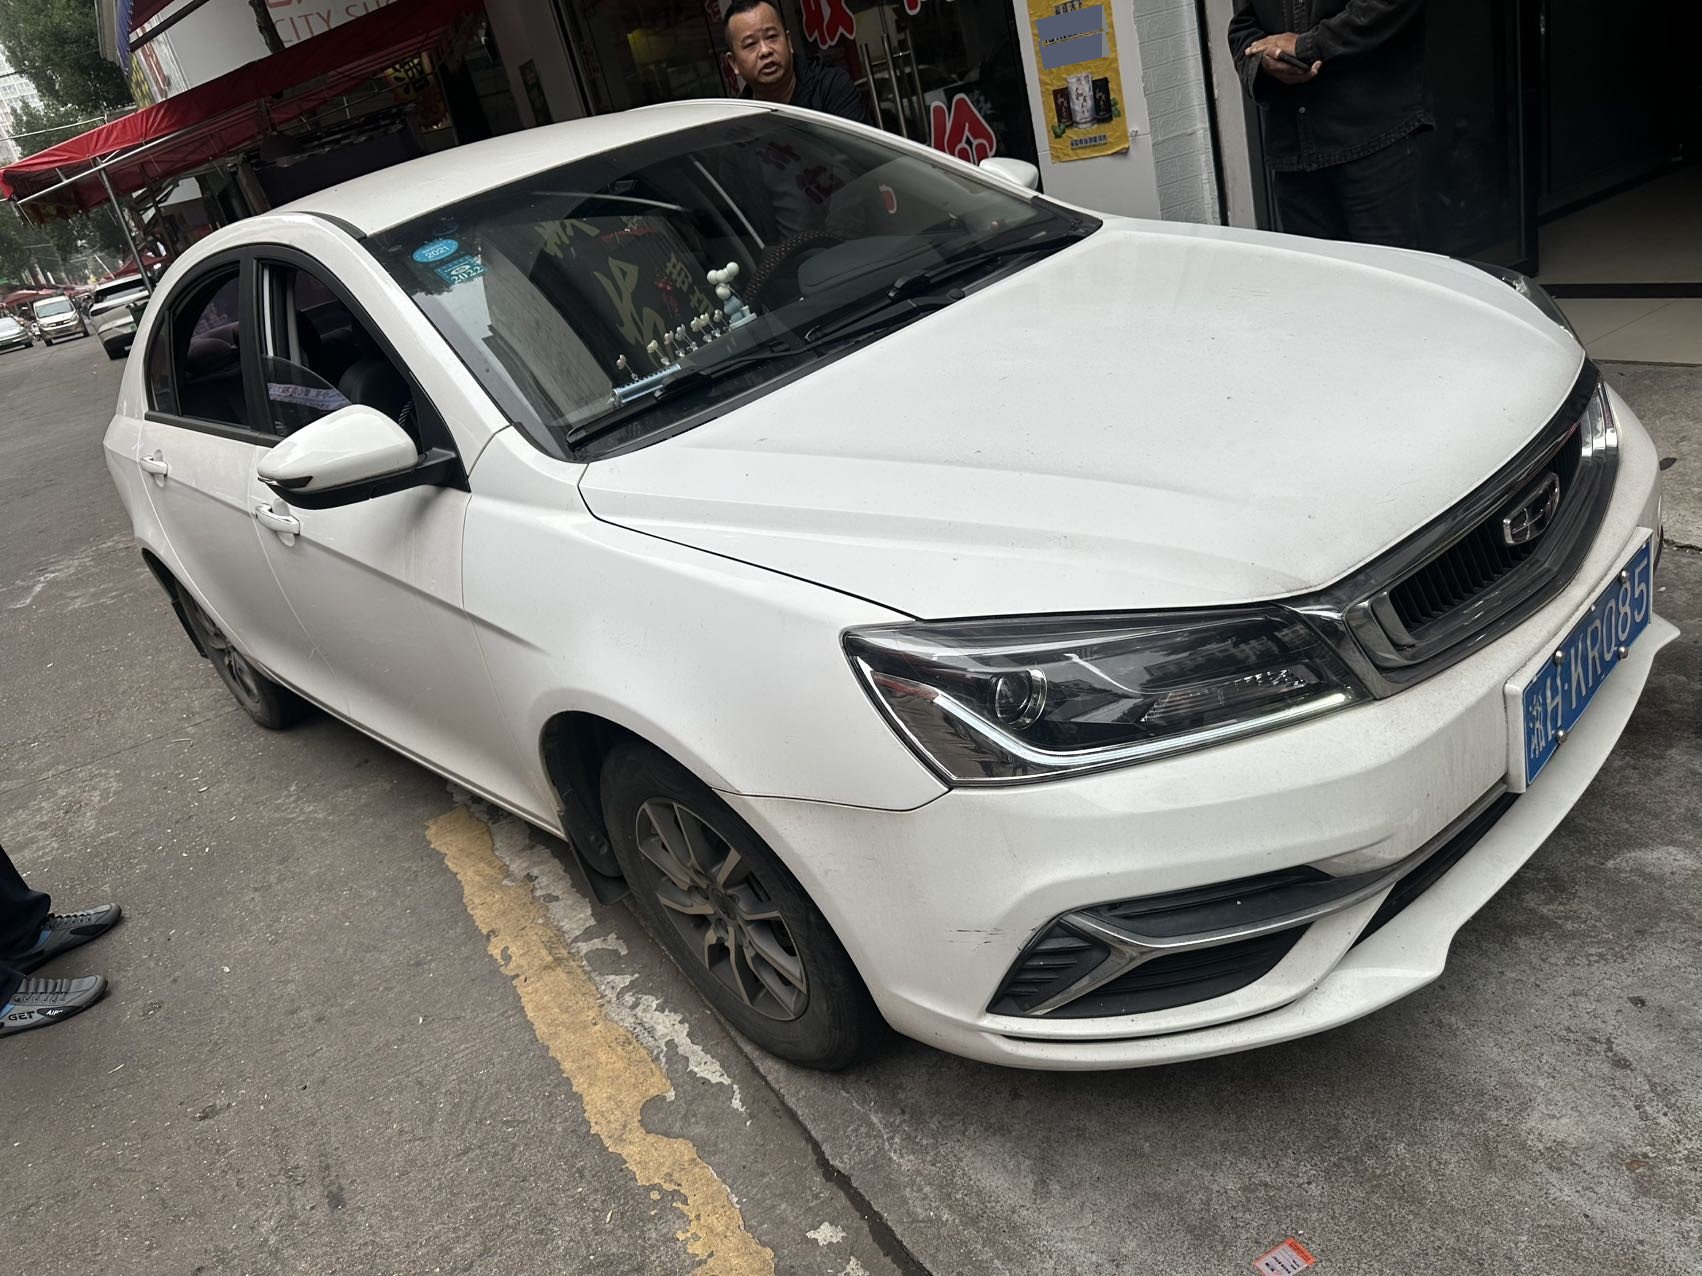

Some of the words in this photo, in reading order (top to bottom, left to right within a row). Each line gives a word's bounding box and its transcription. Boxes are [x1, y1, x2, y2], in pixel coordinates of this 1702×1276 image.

[424, 245, 450, 259] 2021
[450, 266, 485, 285] 2022
[8, 1010, 35, 1021] GET
